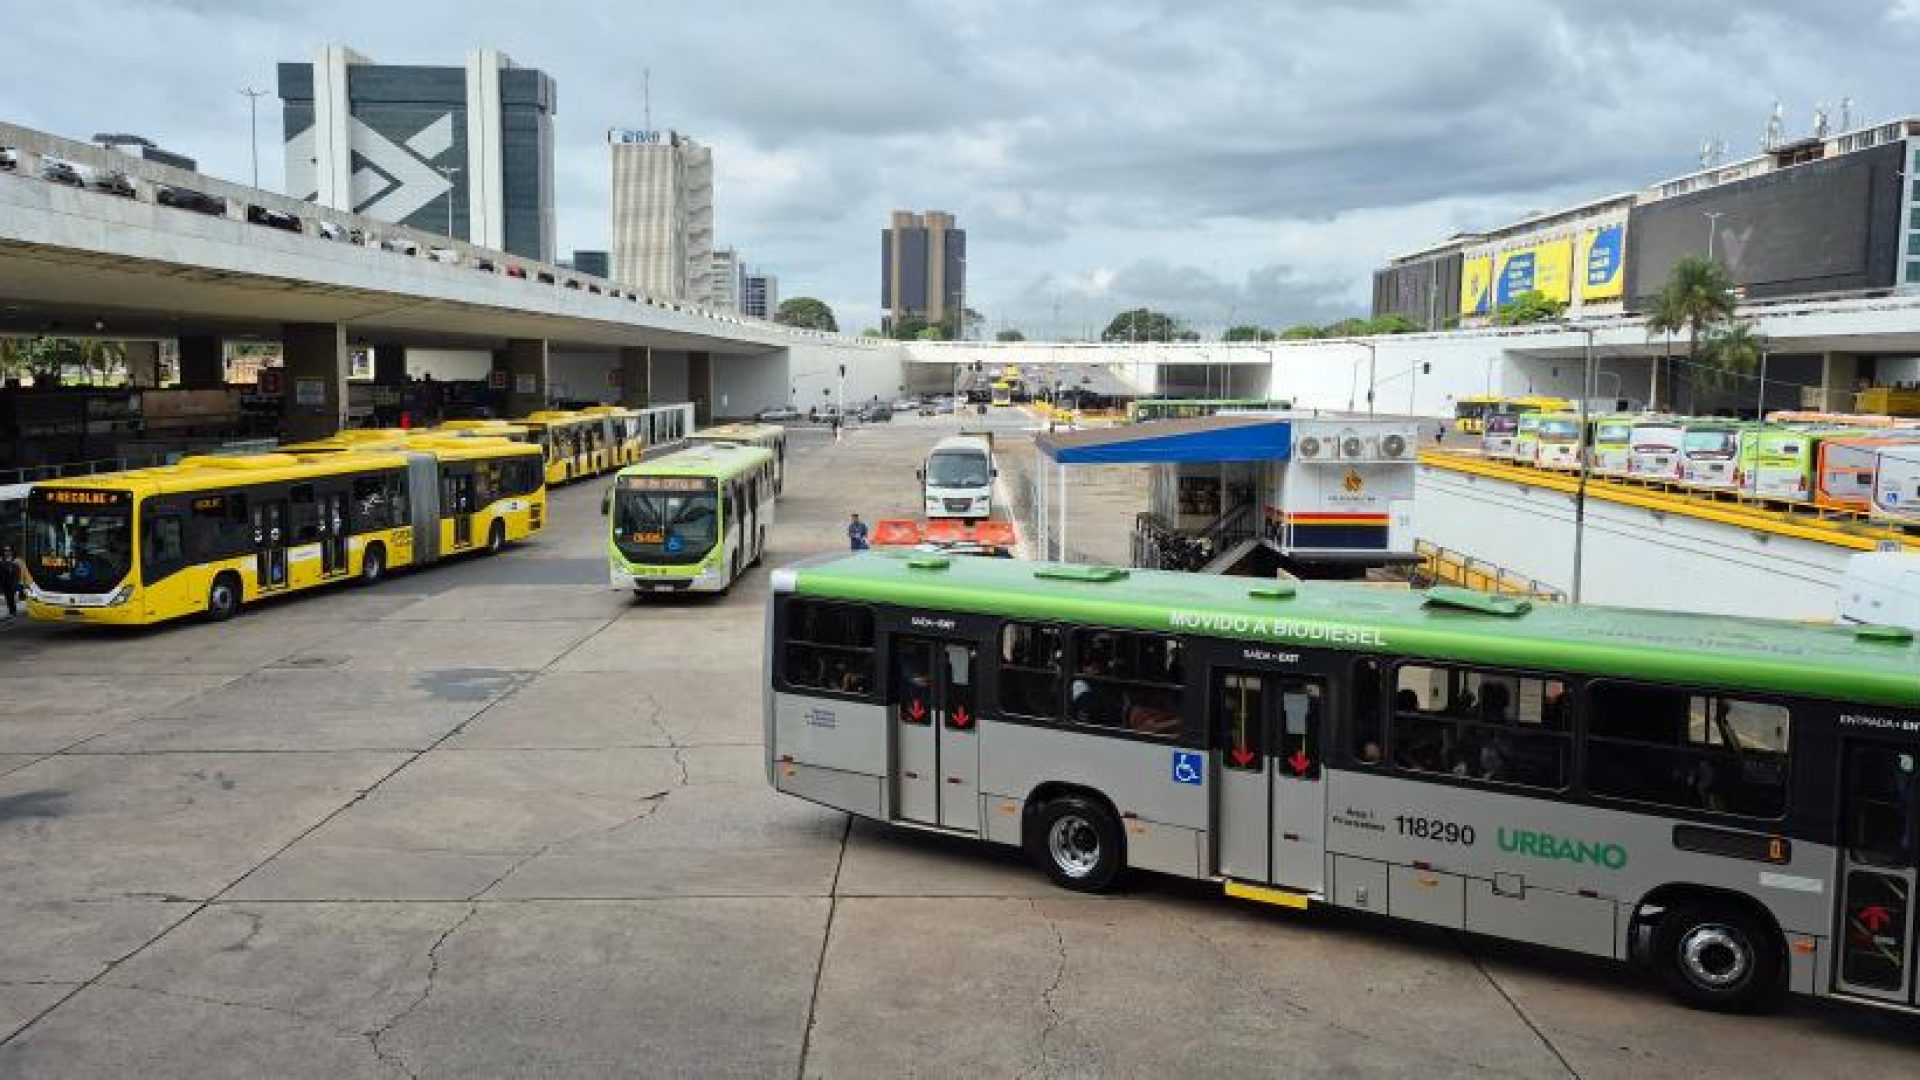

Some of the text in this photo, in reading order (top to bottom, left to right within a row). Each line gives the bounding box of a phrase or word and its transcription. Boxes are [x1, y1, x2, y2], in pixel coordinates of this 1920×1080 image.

[1170, 610, 1388, 646] MOVIDO A BIODIESEL
[1394, 814, 1476, 846] 118290
[1496, 826, 1627, 870] URBANO
